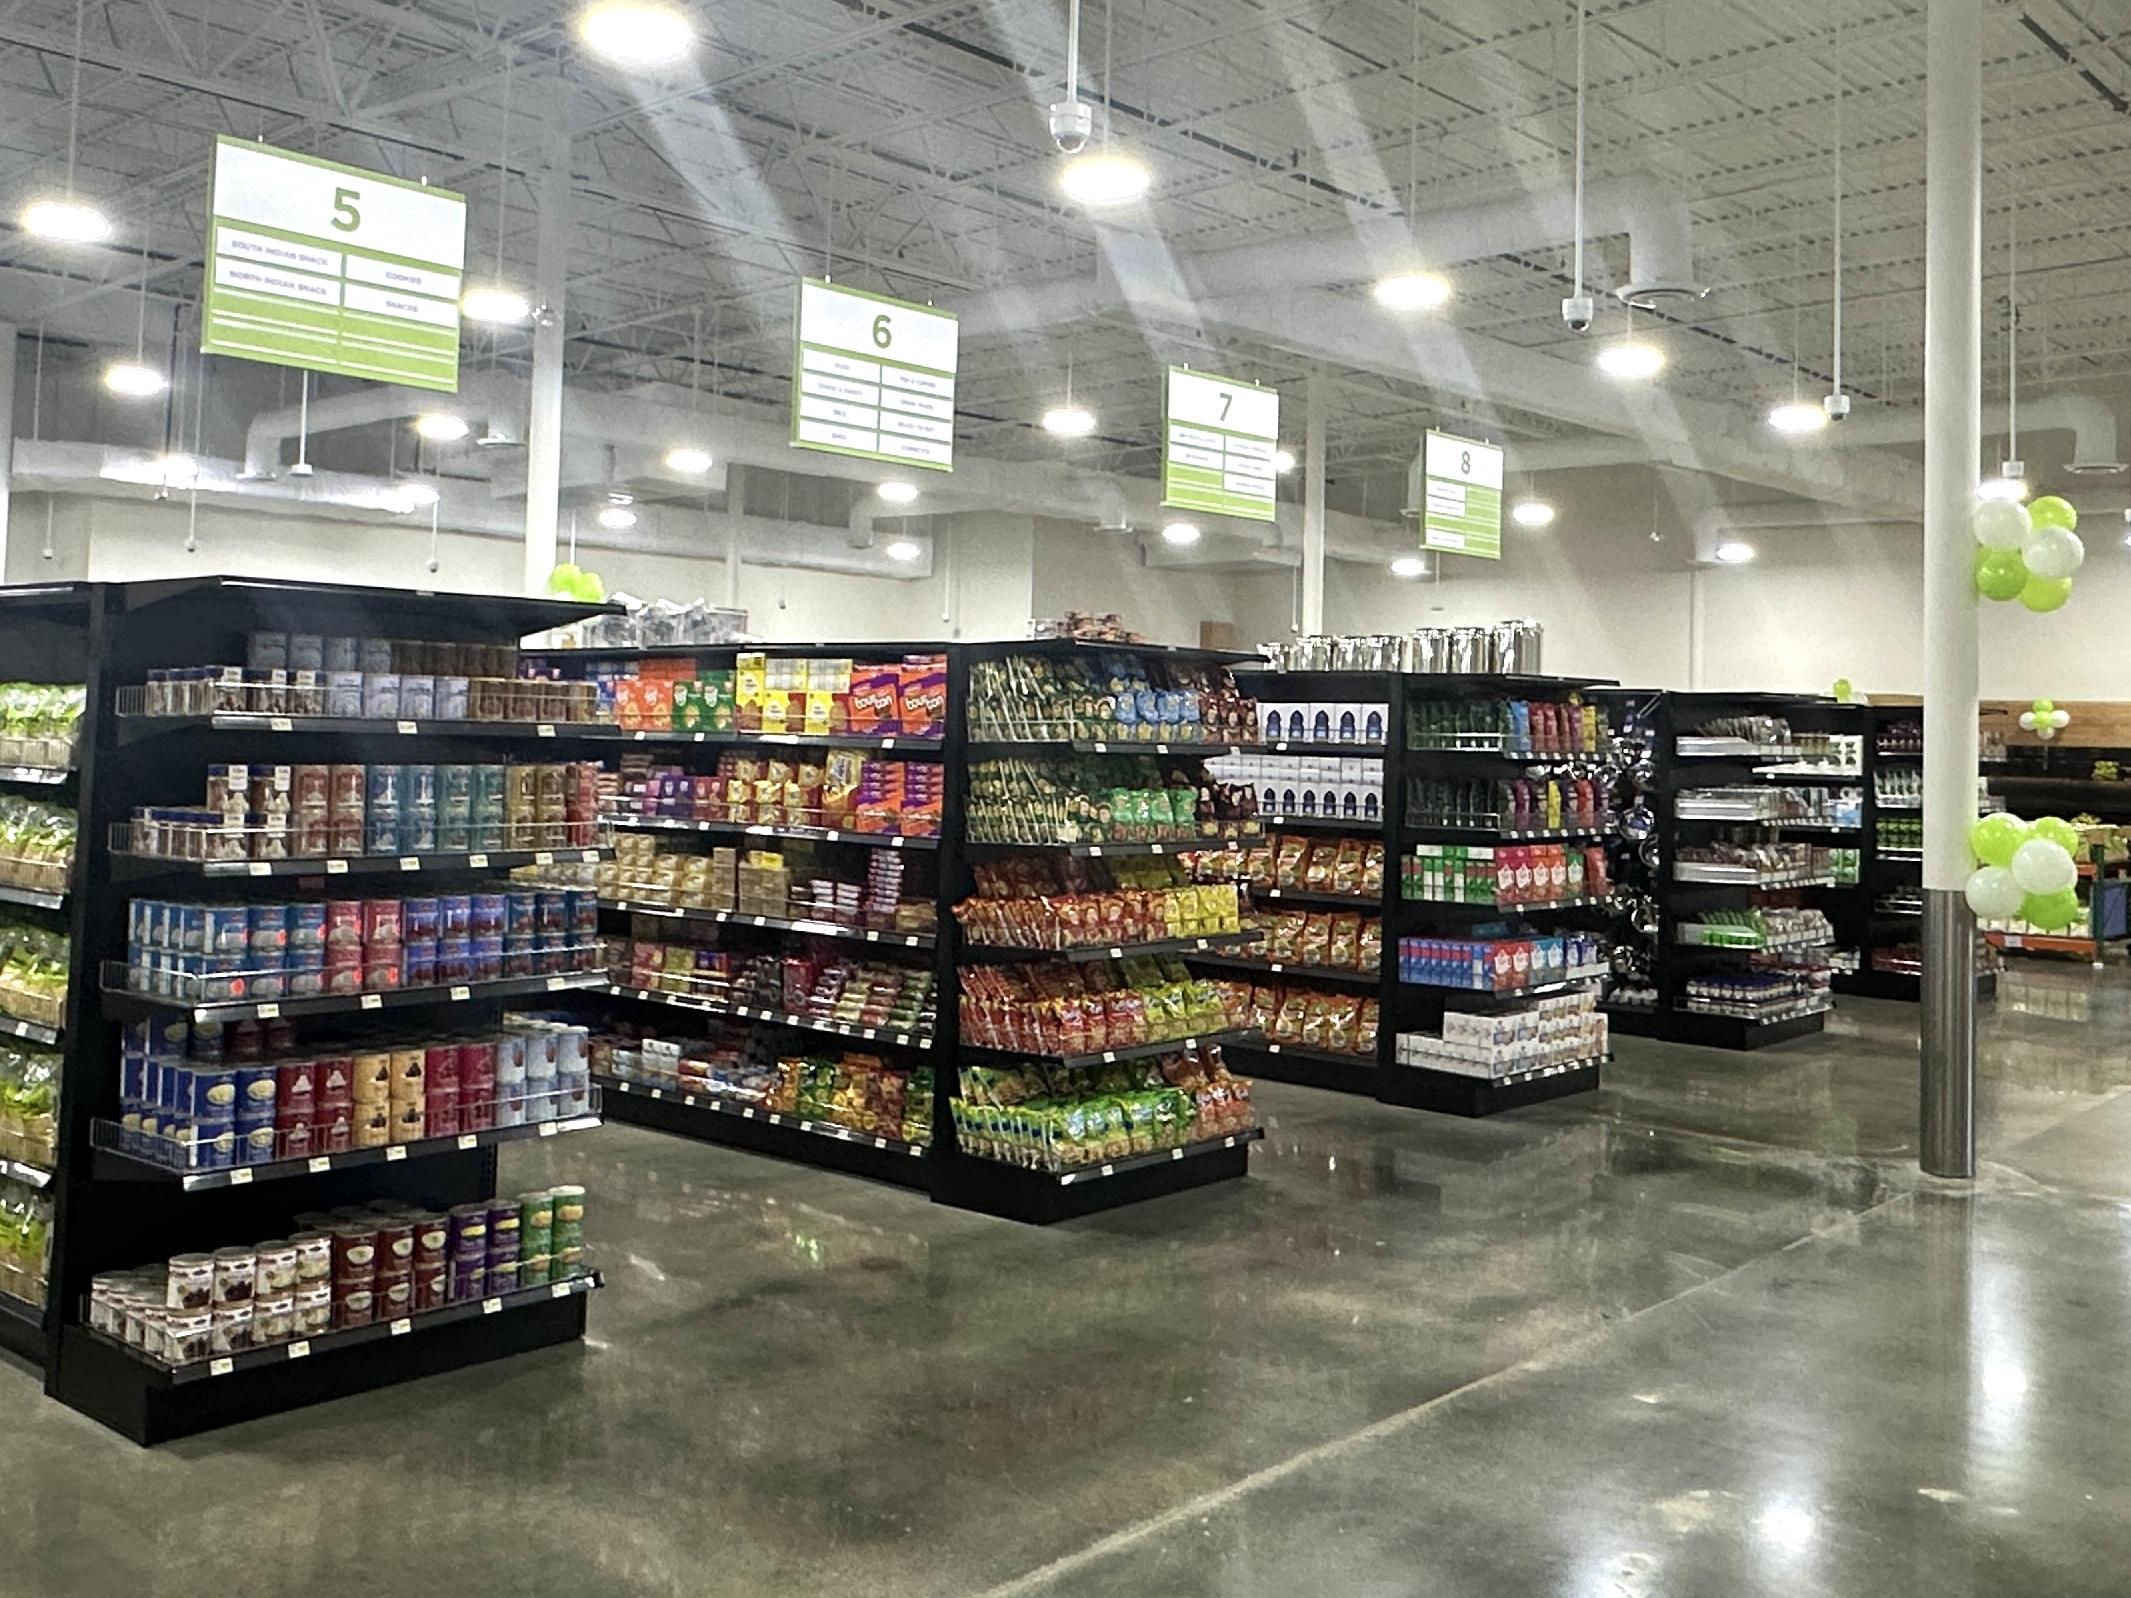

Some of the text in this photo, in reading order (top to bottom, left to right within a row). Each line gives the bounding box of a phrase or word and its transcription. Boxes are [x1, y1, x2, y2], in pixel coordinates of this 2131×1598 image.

[330, 186, 361, 233] 5
[265, 246, 296, 260] INDIAN
[263, 276, 295, 289] INDIAN
[872, 314, 892, 349] 6
[1219, 392, 1233, 421] 7
[1461, 450, 1471, 475] 8
